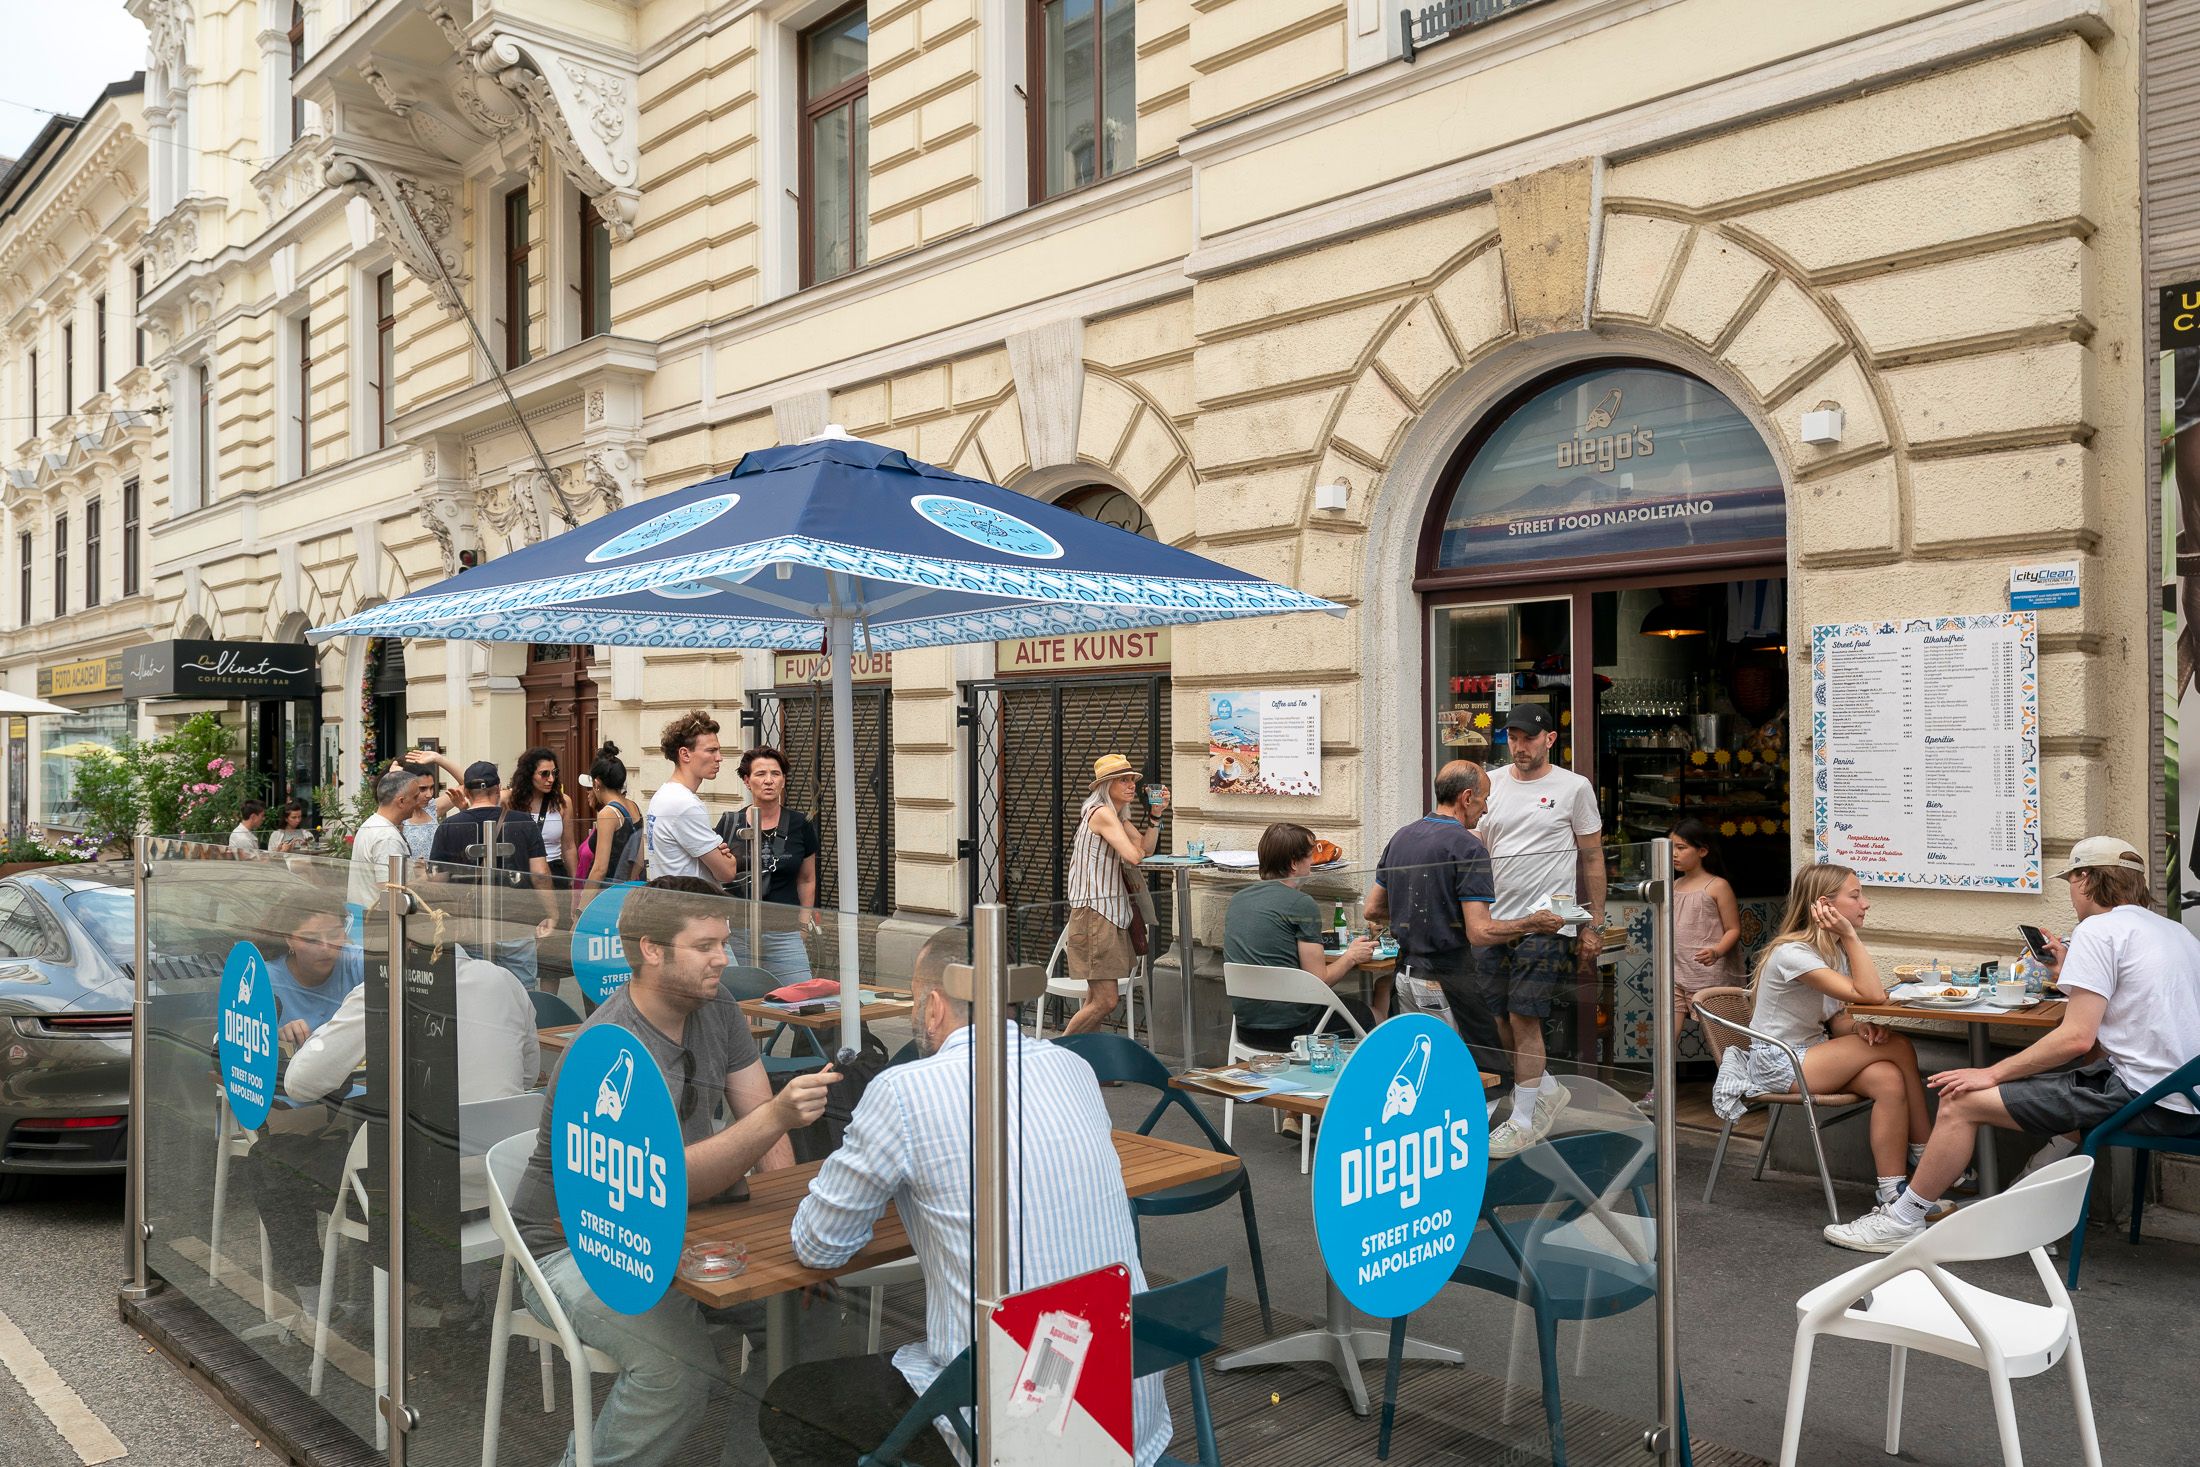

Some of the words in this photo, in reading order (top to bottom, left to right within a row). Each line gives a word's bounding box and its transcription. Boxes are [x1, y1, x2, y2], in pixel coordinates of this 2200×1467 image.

[1557, 425, 1655, 472] Diego's
[1508, 518, 1555, 536] STREET
[1559, 514, 1602, 531] FOOD
[1604, 500, 1714, 525] NAPOLETANO
[2016, 569, 2074, 582] cityClean
[1015, 638, 1065, 664] ALTE
[1074, 632, 1159, 661] KUNST
[1831, 641, 1853, 649] Street
[1854, 640, 1872, 650] food
[1923, 634, 1965, 645] Alkoholfrei
[55, 667, 71, 689] FOTO
[72, 663, 103, 687] ACADEMY
[198, 650, 288, 675] Vivet
[785, 652, 892, 679] FUNDRUBE
[198, 675, 233, 683] COFFEE
[237, 676, 269, 684] EATERY
[1833, 757, 1855, 765] Panini
[1925, 800, 1943, 809] Bier
[1927, 852, 1947, 860] Wein
[225, 999, 270, 1064] Diego's
[231, 1065, 248, 1082] STREET
[248, 1072, 263, 1089] FOOD
[230, 1081, 265, 1108] NAPOLETANO
[567, 1111, 667, 1213] Diego's
[1340, 1109, 1469, 1210] Diego's
[580, 1208, 615, 1240] STREET
[618, 1226, 651, 1256] FOOD
[1361, 1223, 1409, 1257] STREET
[1412, 1208, 1453, 1239] FOOD
[578, 1232, 654, 1284] NAPOLETANO
[1358, 1233, 1456, 1286] NAPOLETANO
